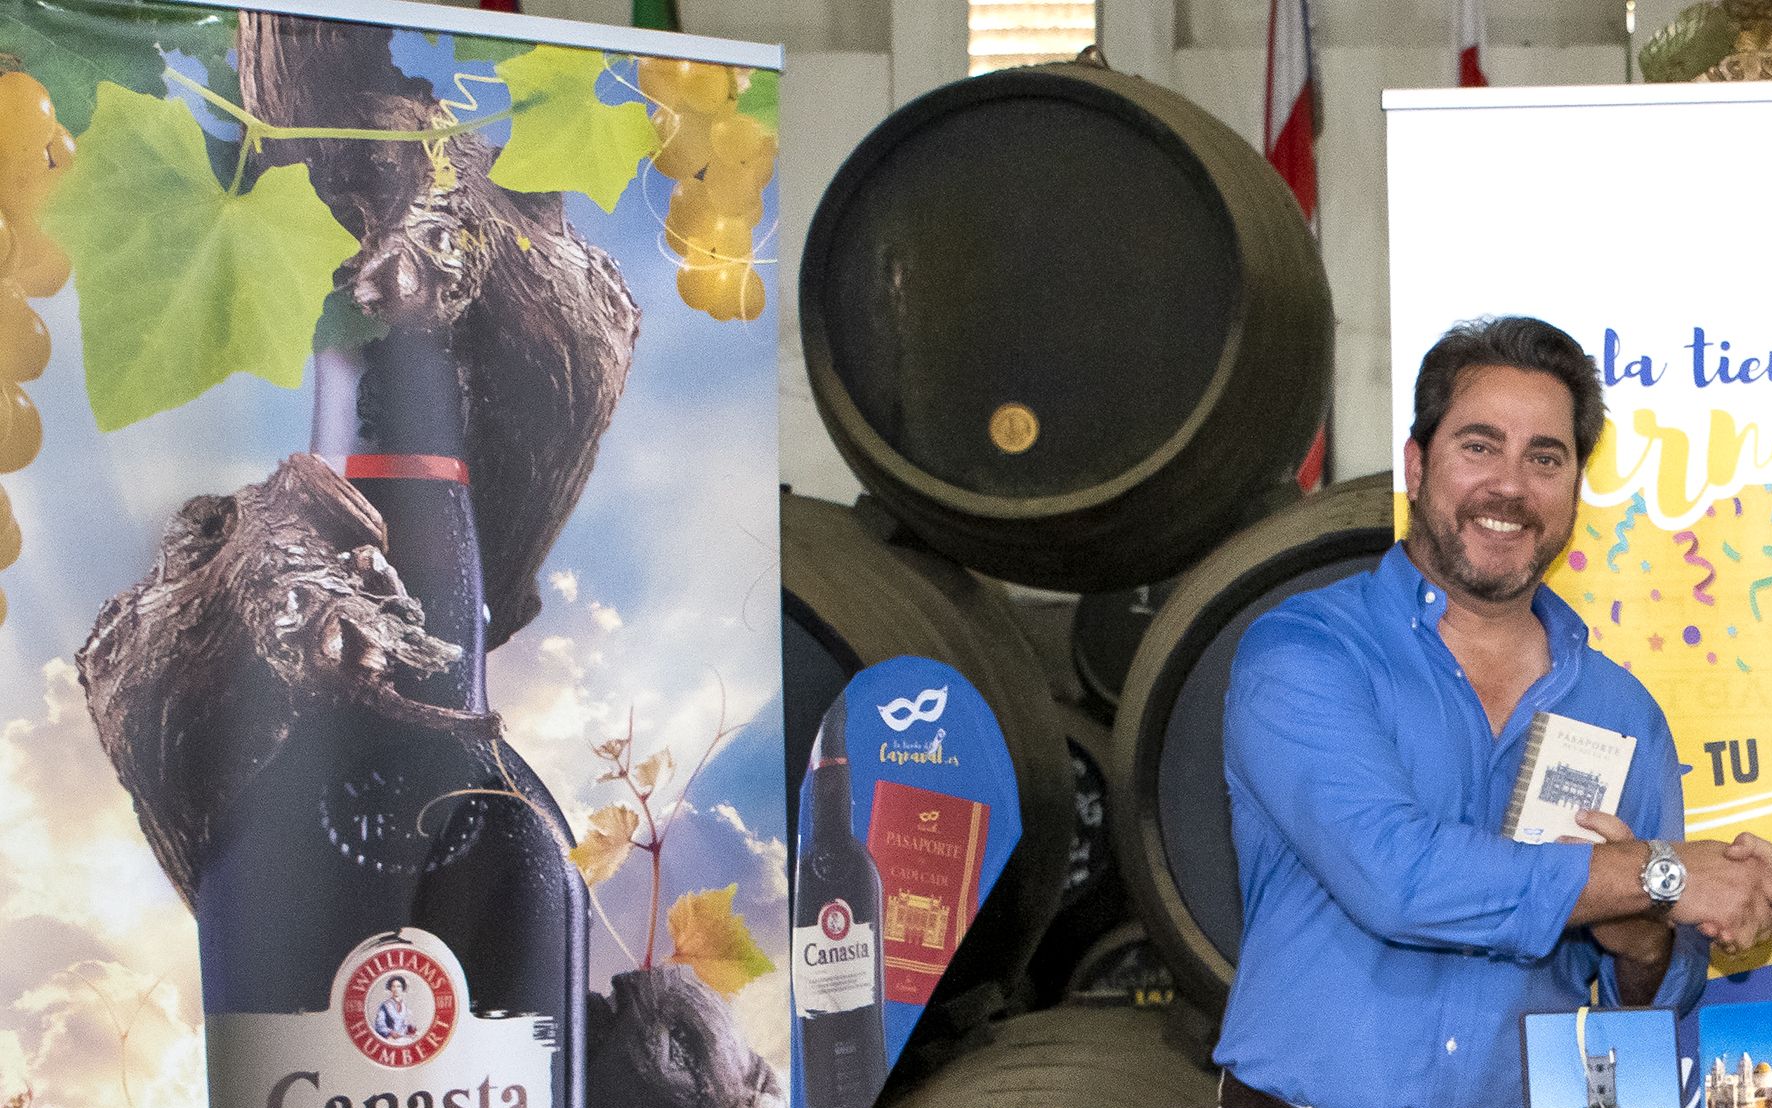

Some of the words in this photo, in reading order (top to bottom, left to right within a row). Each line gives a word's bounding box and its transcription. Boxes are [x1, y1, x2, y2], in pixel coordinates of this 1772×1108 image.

[1604, 327, 1667, 388] la
[1704, 738, 1760, 786] TU
[352, 951, 447, 993] WILLIAMS
[804, 942, 870, 967] Canasta
[350, 1015, 449, 1066] HUMBERT
